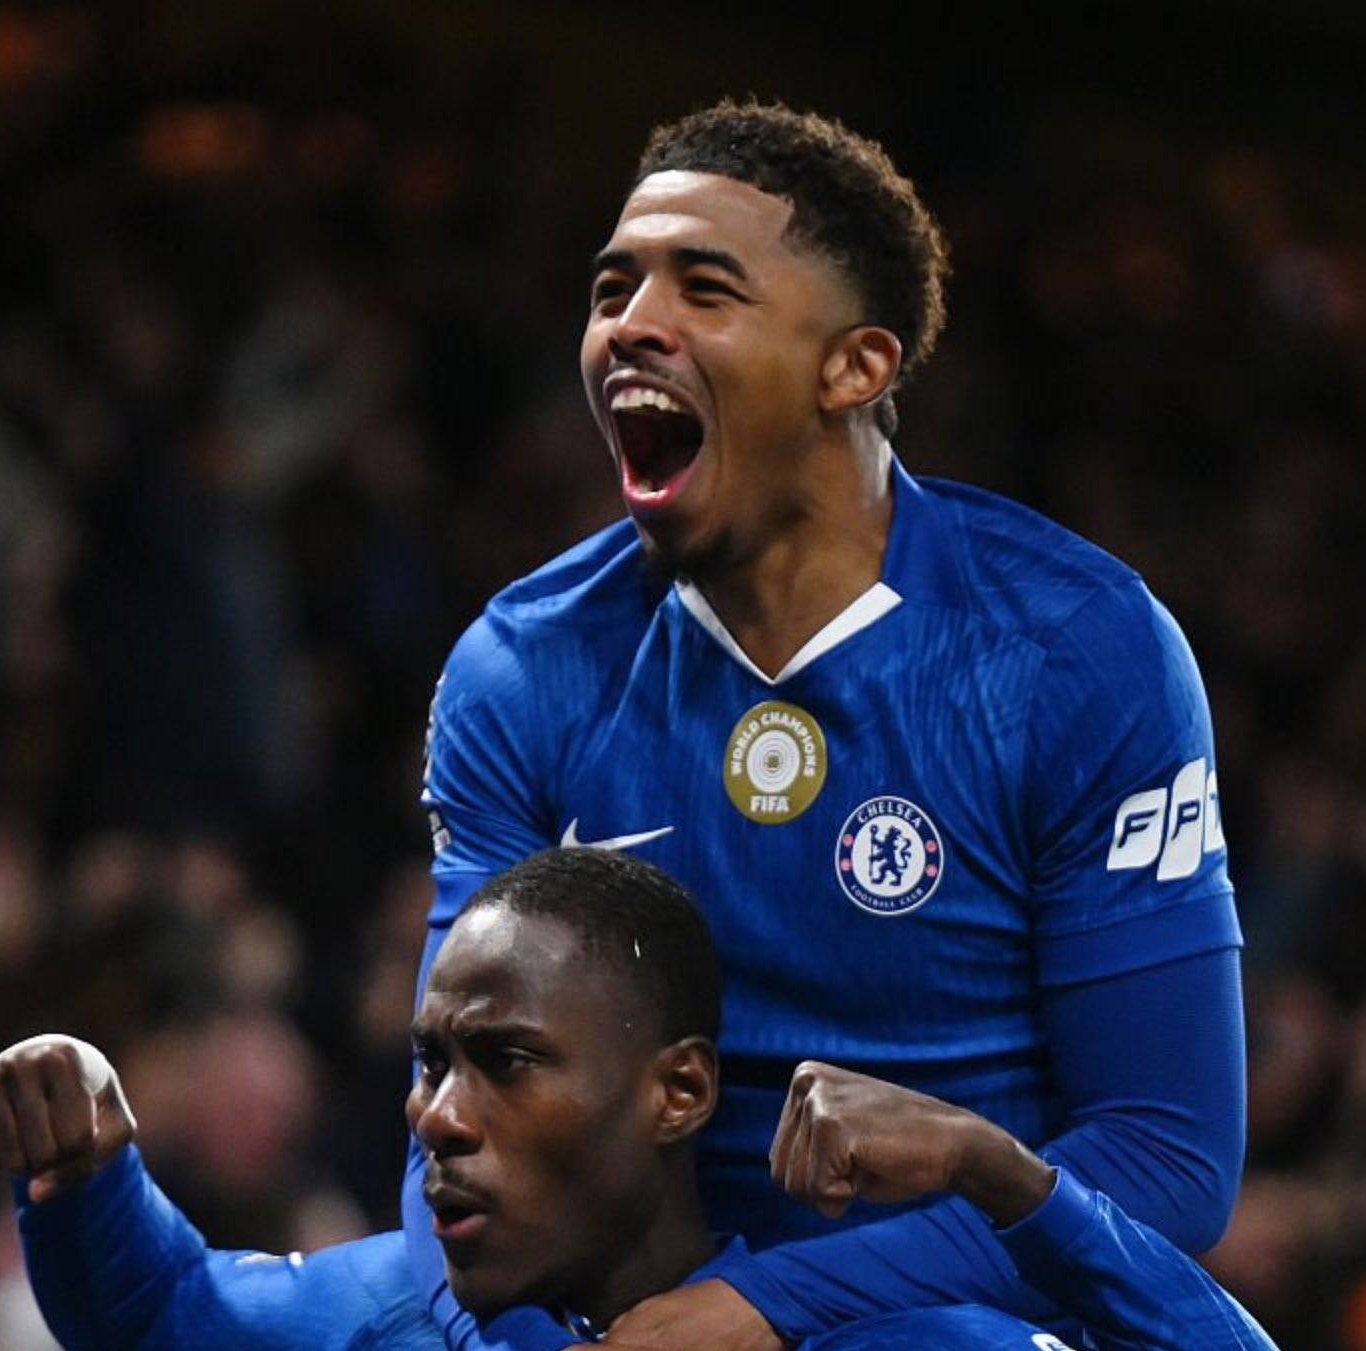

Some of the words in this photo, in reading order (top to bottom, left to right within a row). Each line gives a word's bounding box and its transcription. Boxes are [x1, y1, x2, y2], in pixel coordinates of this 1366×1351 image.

[731, 721, 761, 776] WORLD
[760, 711, 816, 777] CHAMPIONS
[750, 795, 790, 813] FIFA
[857, 801, 922, 828] CHELSEA
